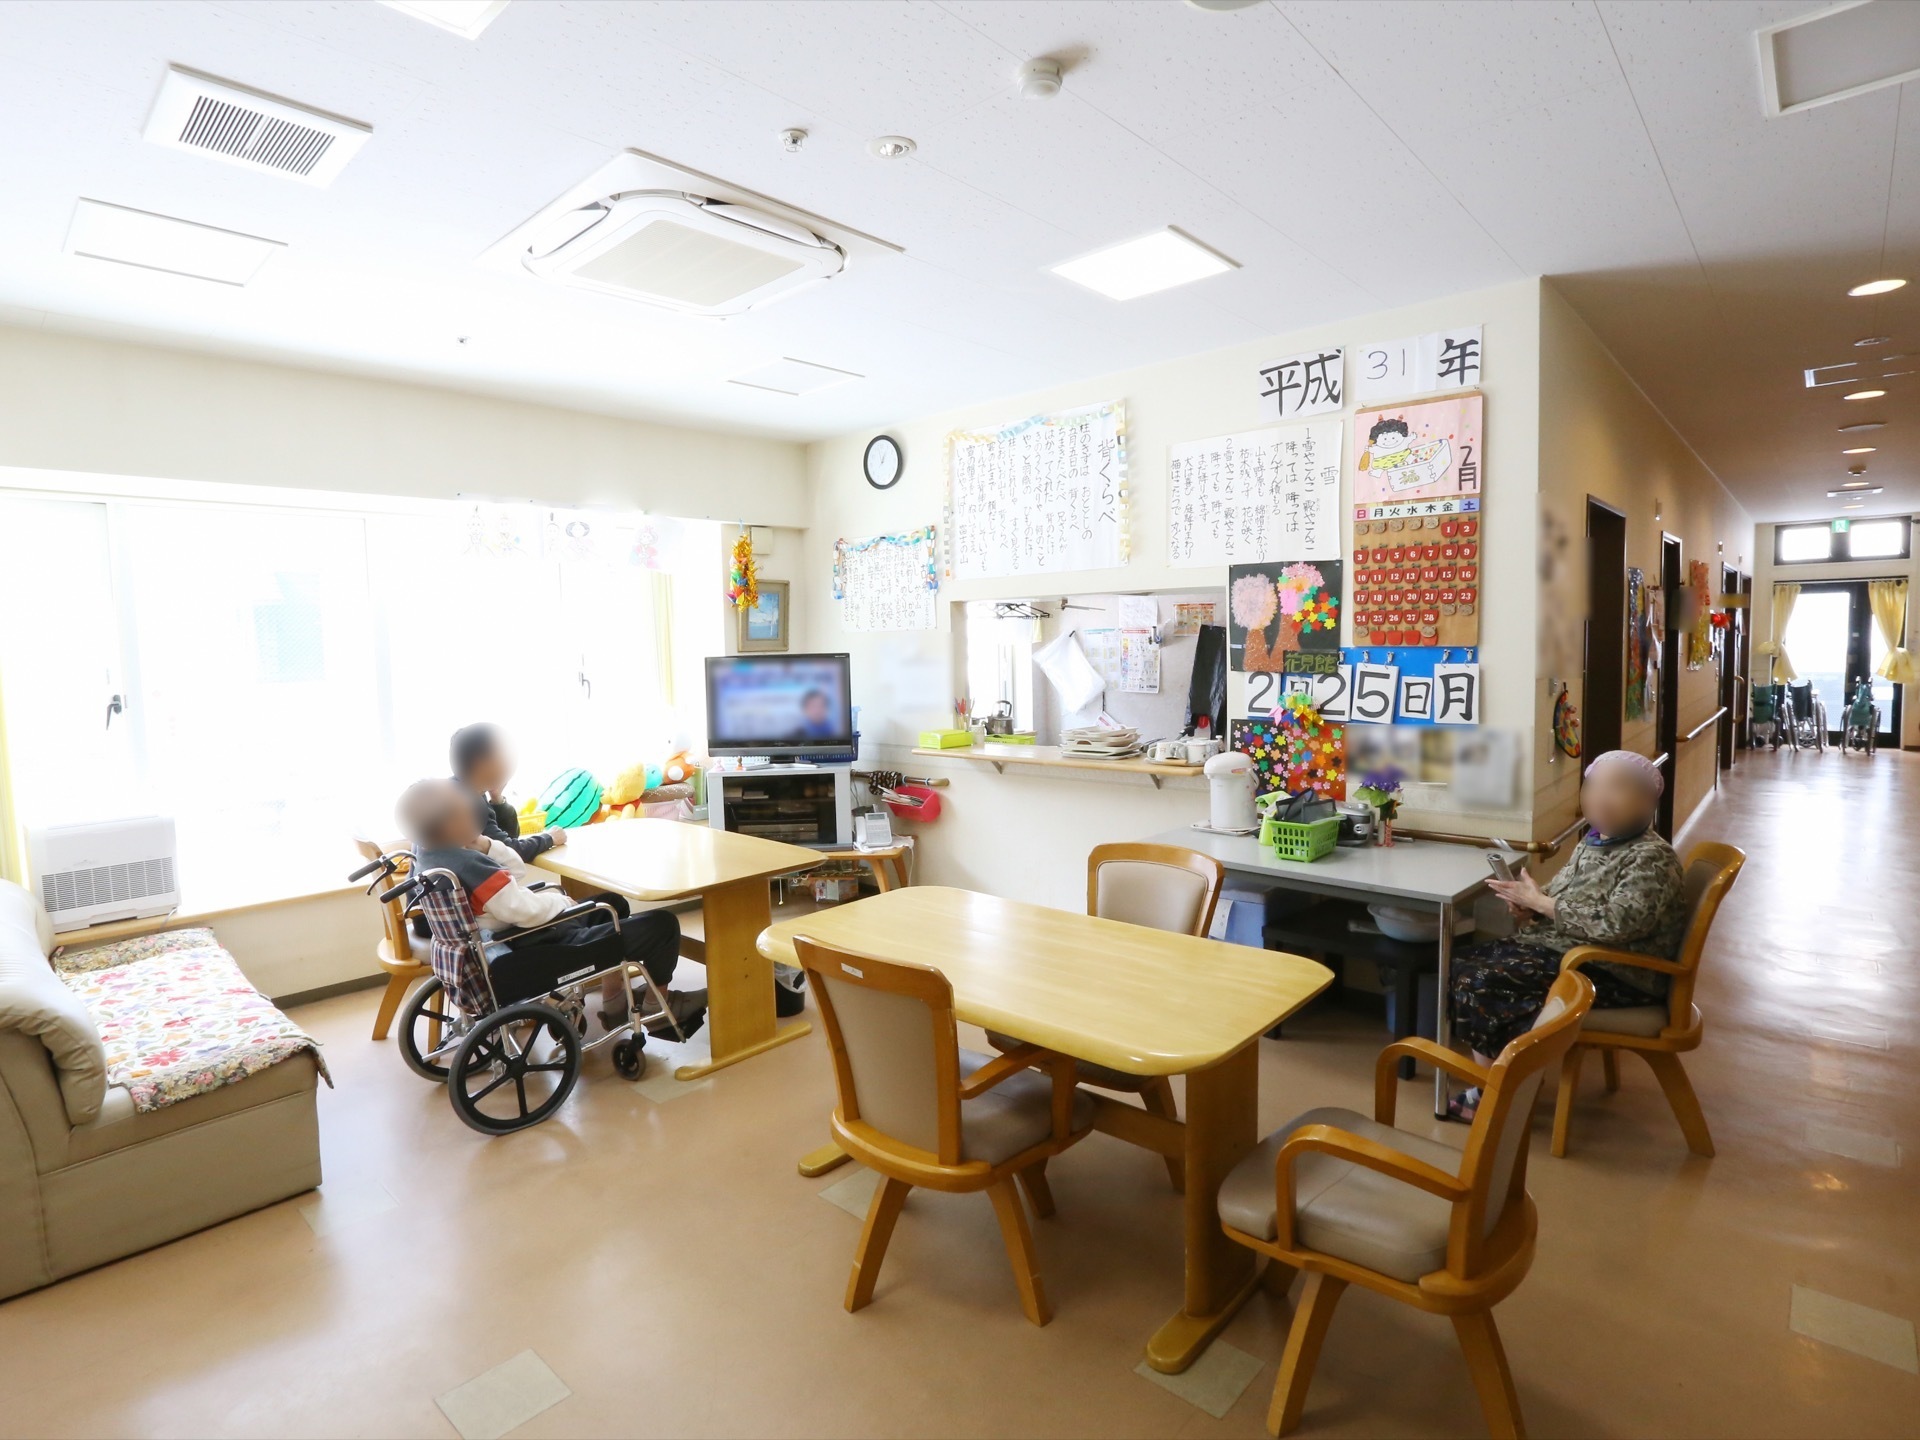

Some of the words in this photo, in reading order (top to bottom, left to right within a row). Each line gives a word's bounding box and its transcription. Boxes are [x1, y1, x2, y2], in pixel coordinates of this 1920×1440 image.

[1259, 349, 1342, 416] 平成
[1367, 349, 1406, 379] 31
[1437, 338, 1479, 385] 年
[1044, 429, 1055, 503] はかってくれた
[1056, 427, 1067, 501] ちまきたべたべ
[1068, 425, 1078, 478] 五月五日の
[1080, 424, 1091, 476] 柱のきずは
[1210, 452, 1221, 492] 降っても
[1253, 447, 1266, 497] 山も野原も
[1286, 441, 1298, 483] 降っては
[1459, 446, 1476, 491] 2月
[1098, 438, 1117, 523] 背くらべ
[1184, 456, 1194, 496] 犬は喜び
[1198, 453, 1209, 523] まだ降りやまず
[1269, 442, 1283, 515] ずんずん積もる
[1320, 466, 1338, 485] 雪
[1069, 487, 1079, 530] 背くらべ
[1082, 487, 1092, 540] おととしの
[1211, 500, 1222, 539] 降っても
[1241, 506, 1253, 545] 花が咲く
[1286, 492, 1300, 532] 降っては
[1357, 510, 1366, 519] 日
[1374, 508, 1383, 517] 月
[1390, 507, 1400, 515] 火
[1407, 506, 1418, 515] 水
[1425, 504, 1436, 513] 木
[1443, 502, 1453, 512] 金
[1463, 501, 1475, 511] 土
[1046, 513, 1055, 554] 背のたけ
[1255, 505, 1268, 562] 綿帽子かぶり
[1356, 594, 1365, 602] 17
[1373, 594, 1382, 602] 18
[1373, 614, 1382, 622] 25
[1389, 614, 1399, 622] 26
